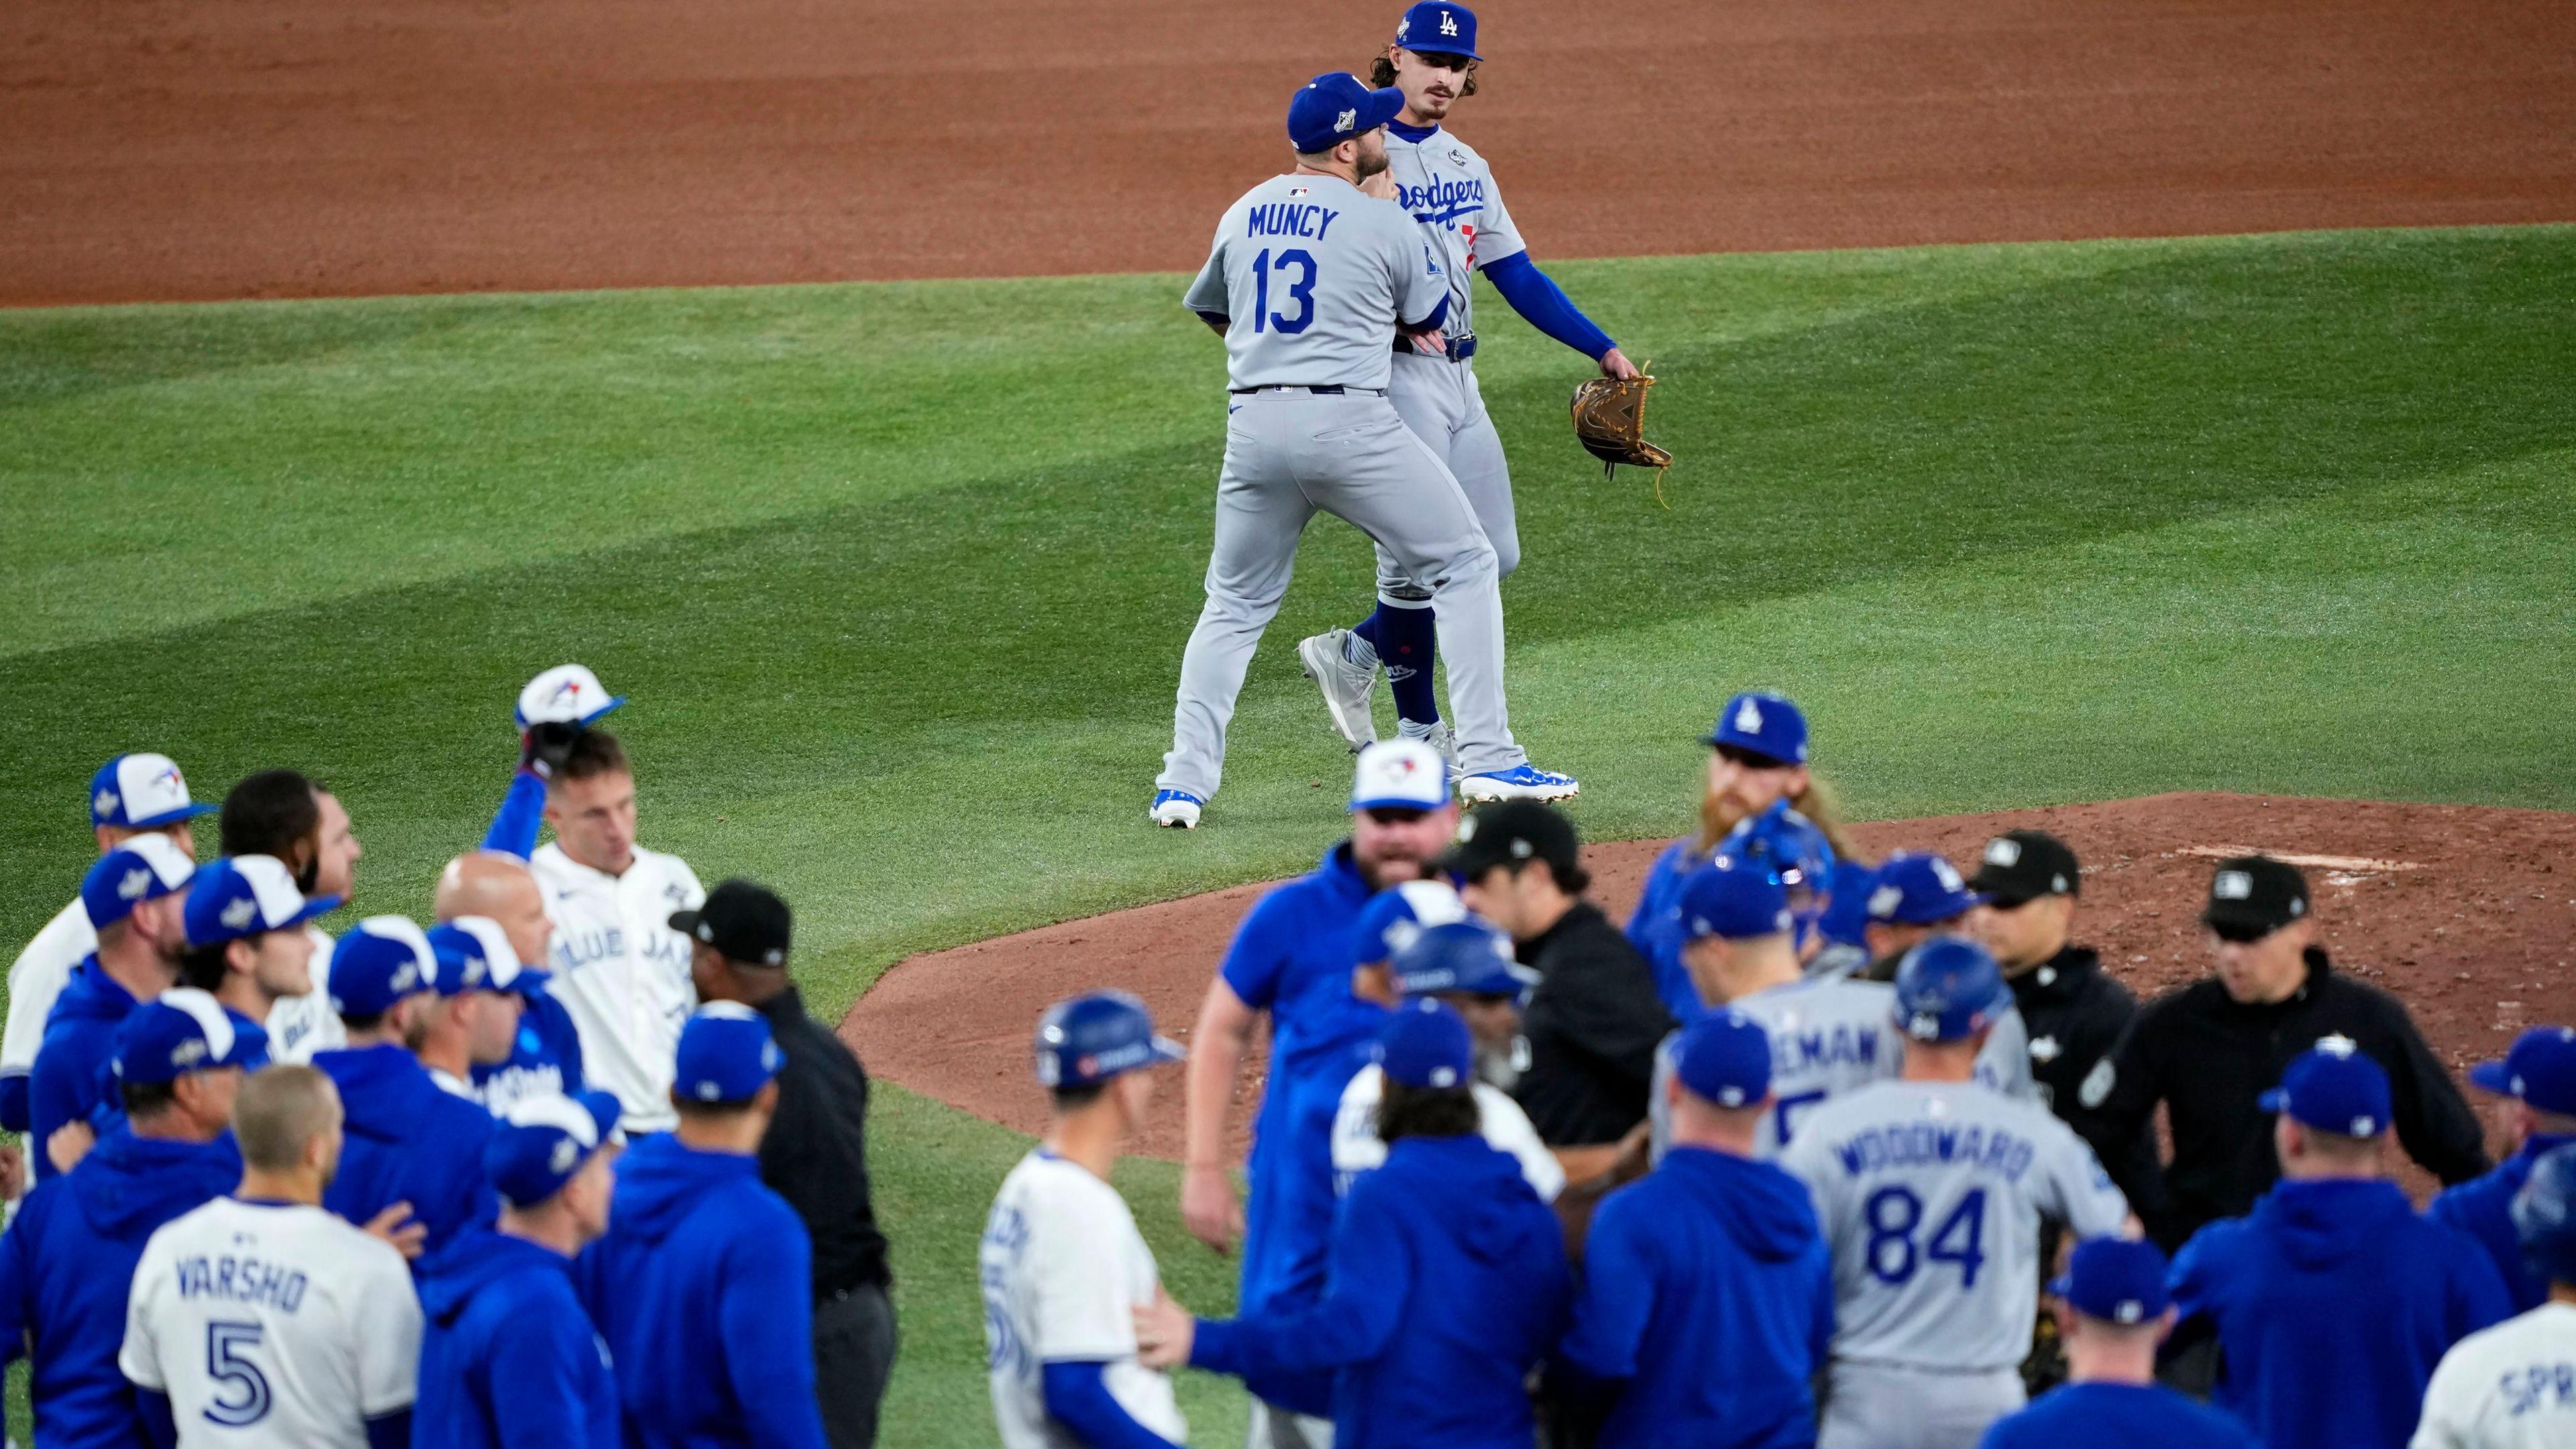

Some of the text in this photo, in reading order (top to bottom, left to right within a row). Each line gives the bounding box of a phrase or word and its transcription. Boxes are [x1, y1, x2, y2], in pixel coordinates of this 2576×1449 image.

[1440, 11, 1458, 36] LA
[1248, 203, 1340, 241] MUNCY
[1252, 248, 1318, 333] 13
[1866, 1185, 1986, 1287] 84
[176, 1254, 307, 1313] VARSHO
[203, 1320, 272, 1427] 5
